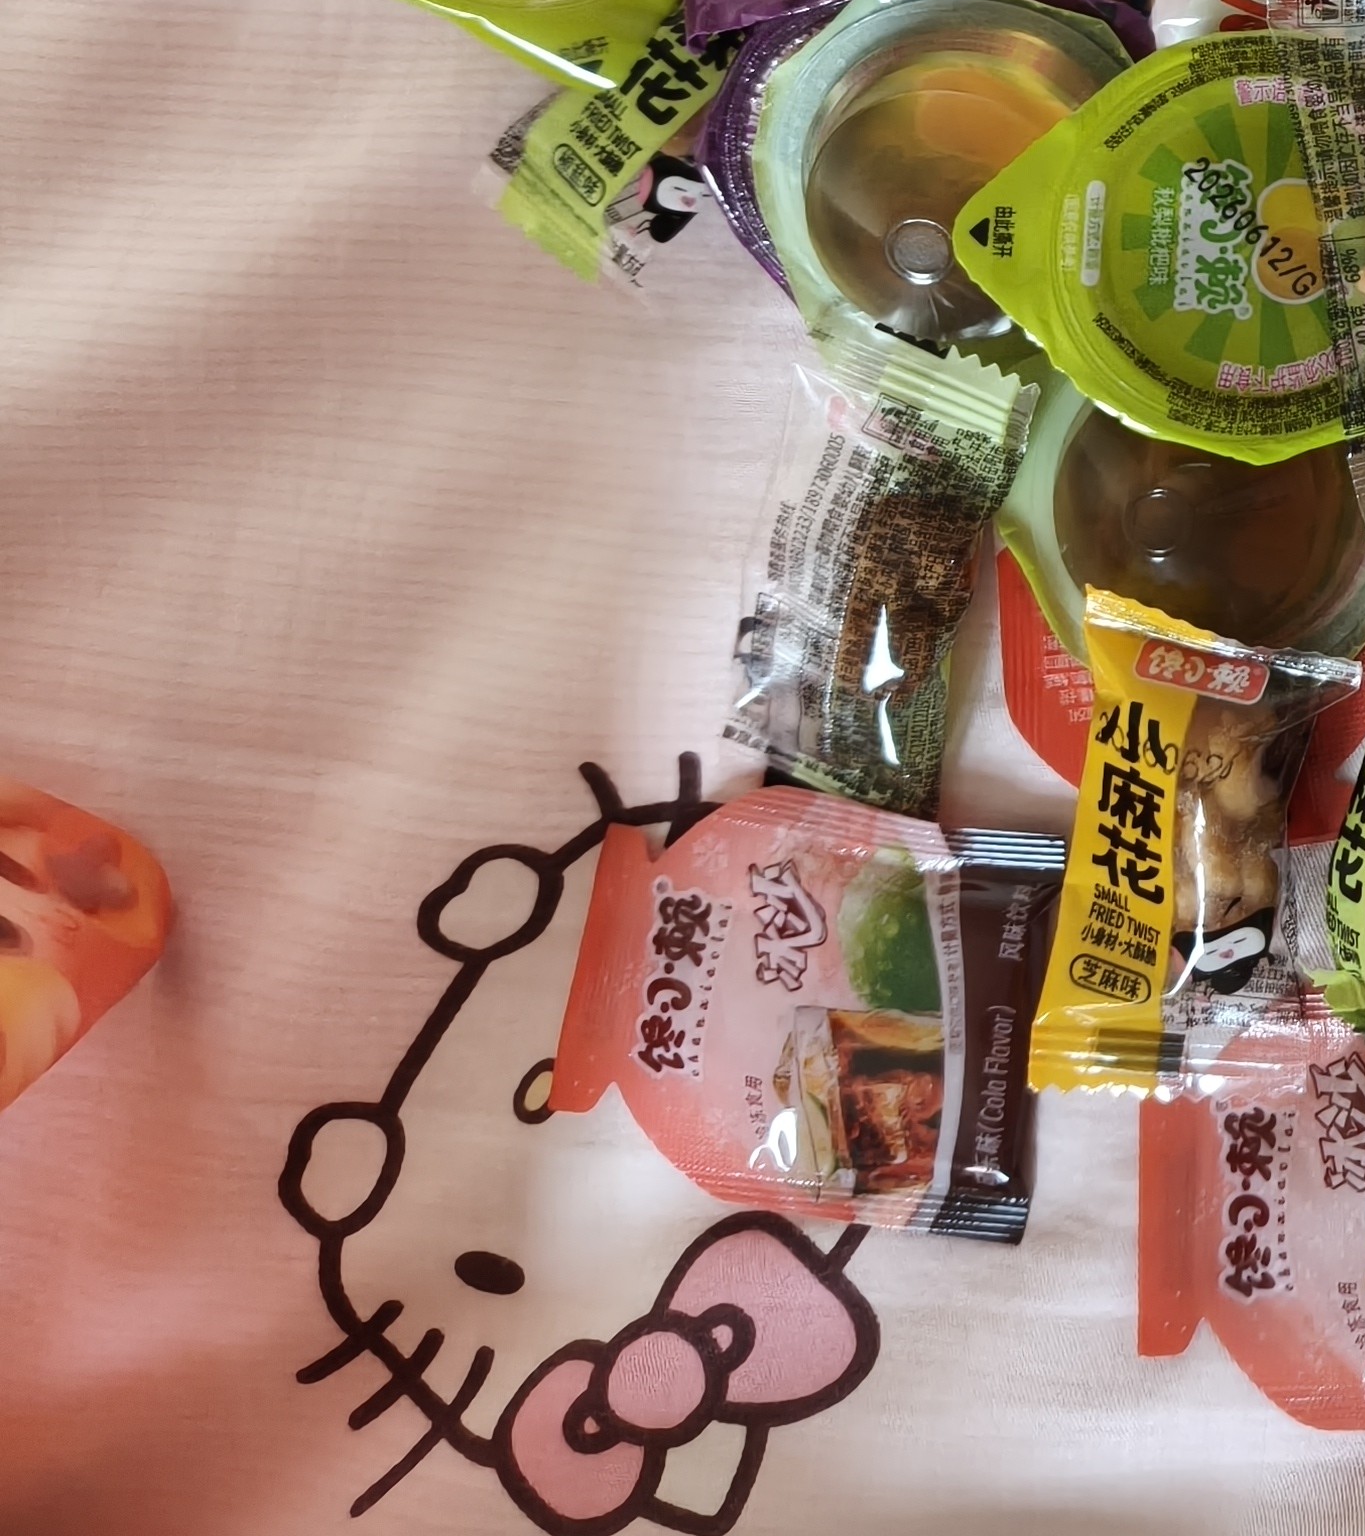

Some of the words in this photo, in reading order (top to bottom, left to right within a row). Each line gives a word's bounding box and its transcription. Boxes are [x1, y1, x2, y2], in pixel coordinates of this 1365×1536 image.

[576, 100, 616, 139] FRIED
[604, 123, 646, 162] TWIST
[546, 146, 607, 203] 椒盐味
[1145, 186, 1175, 287] 秋梨枇杷味
[1182, 157, 1316, 301] 20260612/G
[1143, 643, 1262, 700] 馋小赖
[1091, 702, 1174, 906] 小麻花
[731, 852, 836, 994] 冰沙
[1088, 901, 1127, 933] FRIED
[1124, 914, 1163, 946] TWIST
[1090, 882, 1135, 912] SMALL
[632, 886, 715, 1076] 馋小赖
[1077, 960, 1143, 1002] 芝麻味
[1211, 1104, 1287, 1298] 馋小赖
